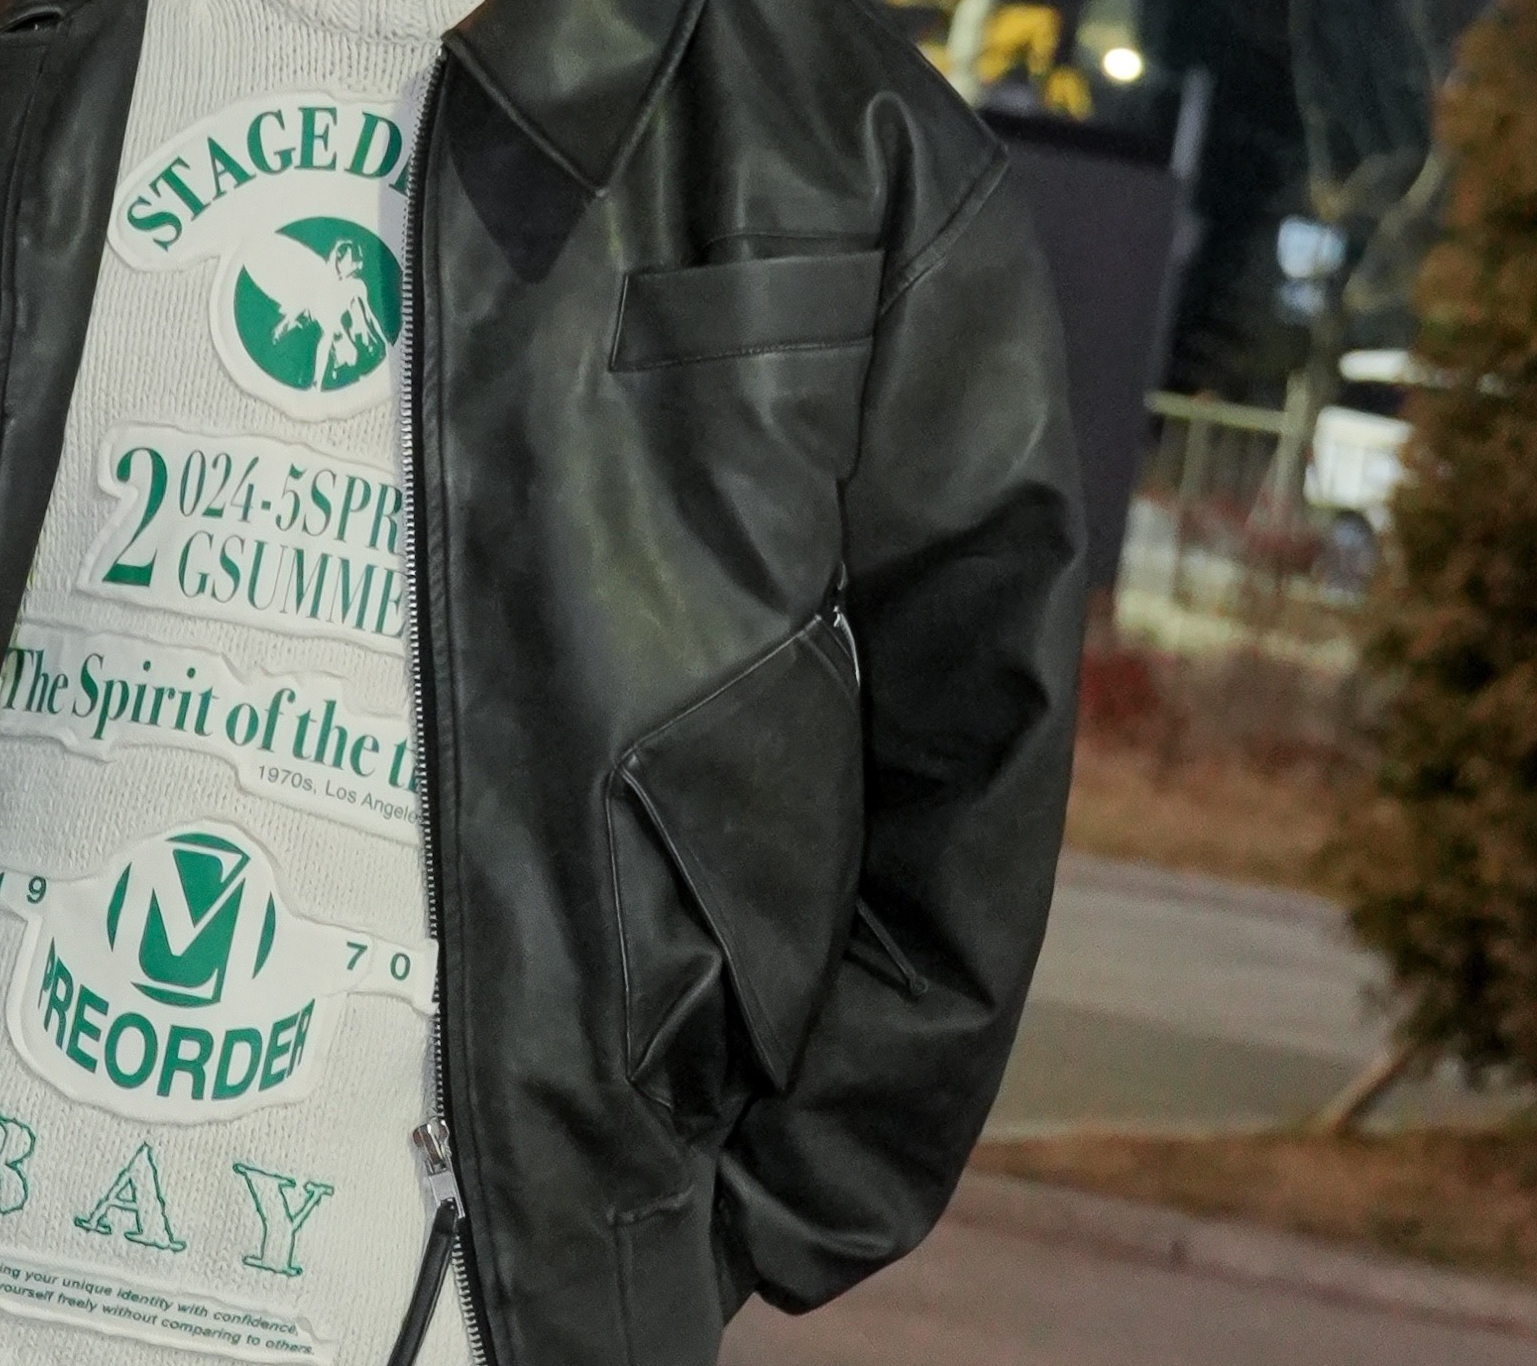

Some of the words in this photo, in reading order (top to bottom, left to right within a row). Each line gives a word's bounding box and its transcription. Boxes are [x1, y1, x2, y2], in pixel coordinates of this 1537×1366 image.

[126, 106, 337, 252] STAGE
[178, 531, 409, 639] GSUMME
[2, 646, 68, 715] The
[71, 653, 219, 740] Spirit
[226, 687, 295, 753] of
[292, 699, 380, 778] the
[258, 765, 317, 795] 1970s,
[325, 779, 357, 804] Los
[38, 936, 315, 1101] PREORDER
[24, 1270, 58, 1286] your
[62, 1278, 113, 1297] unique
[117, 1287, 173, 1311] identity
[177, 1302, 208, 1317] with
[57, 1293, 97, 1312] freely
[102, 1303, 158, 1325] without
[161, 1317, 242, 1346] comparing
[247, 1335, 261, 1346] to
